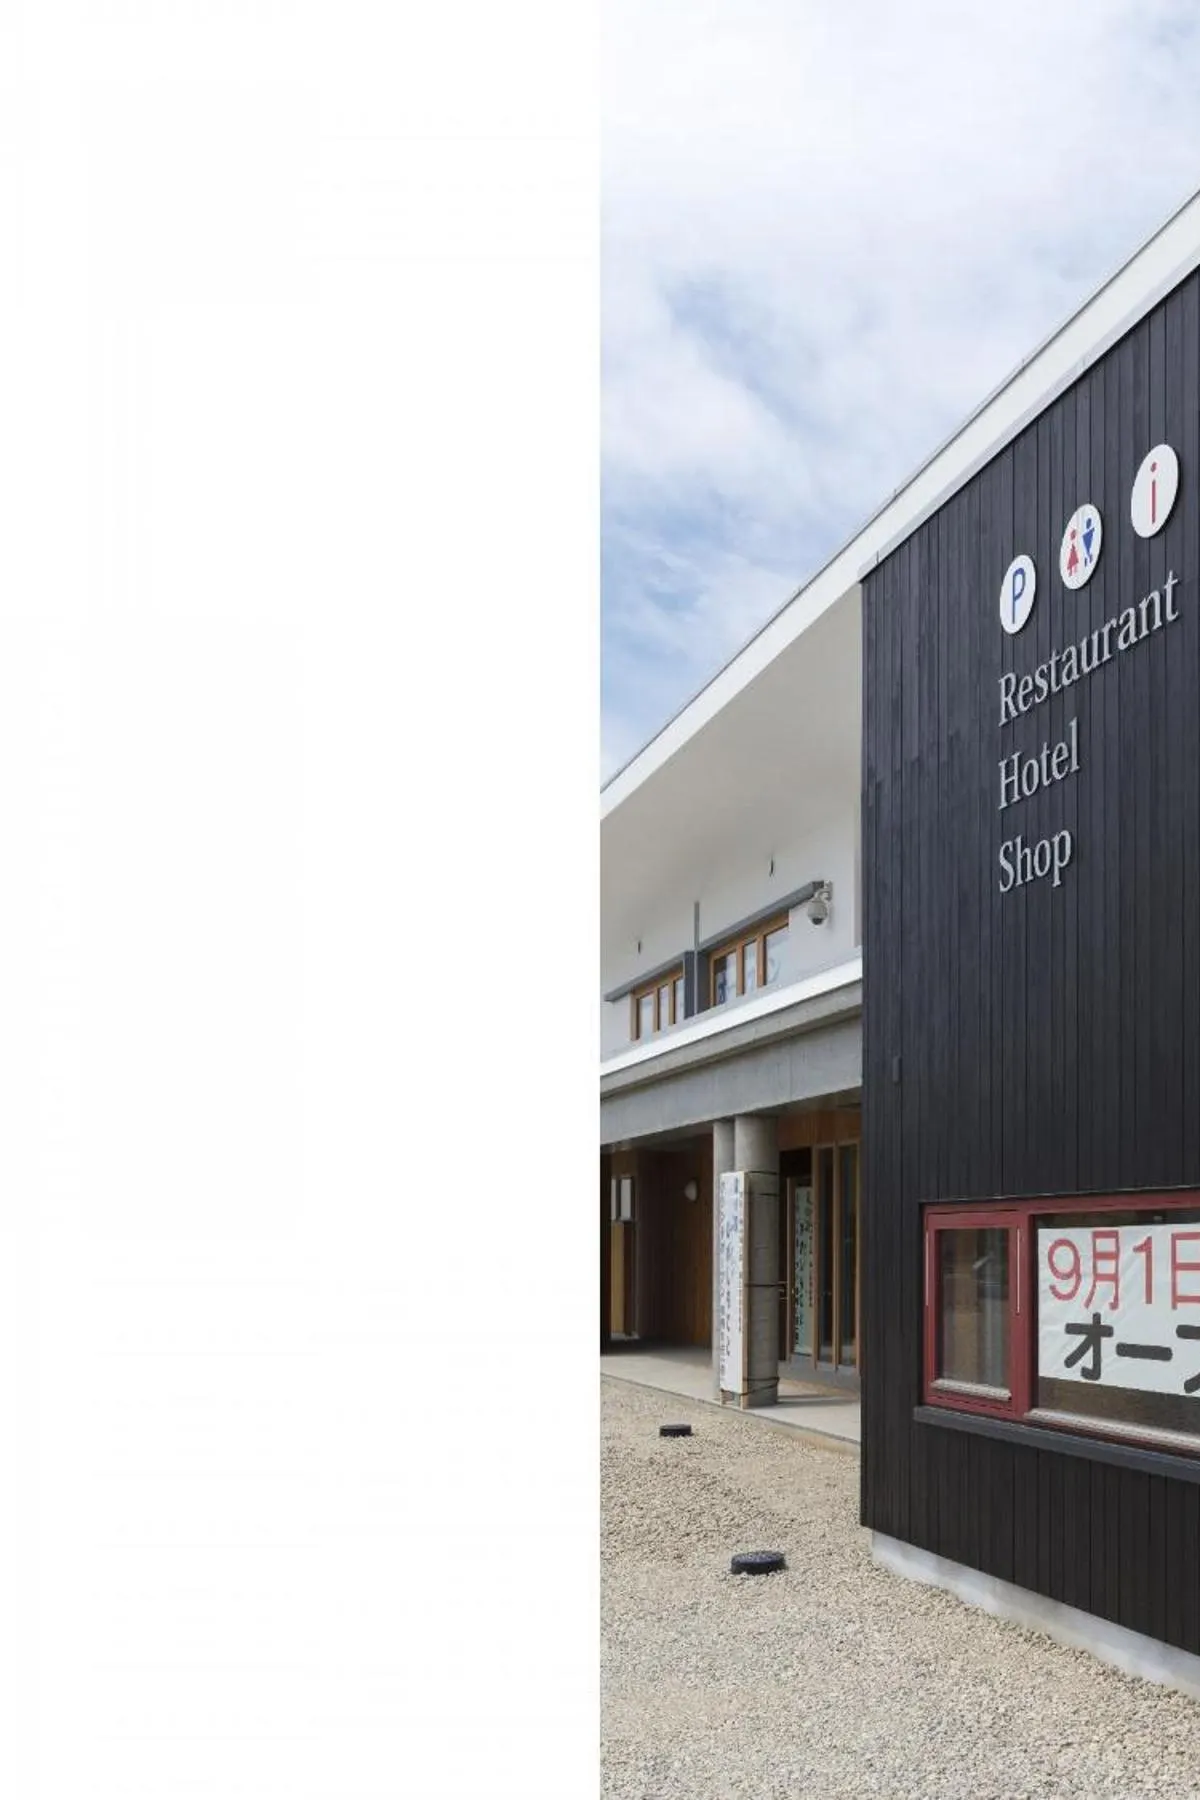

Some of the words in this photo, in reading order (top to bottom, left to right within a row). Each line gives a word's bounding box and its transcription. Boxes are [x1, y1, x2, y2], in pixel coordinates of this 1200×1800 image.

[1011, 567, 1026, 625] P
[998, 569, 1181, 727] Restaurant
[998, 716, 1080, 811] Hotel
[999, 828, 1073, 893] Shop
